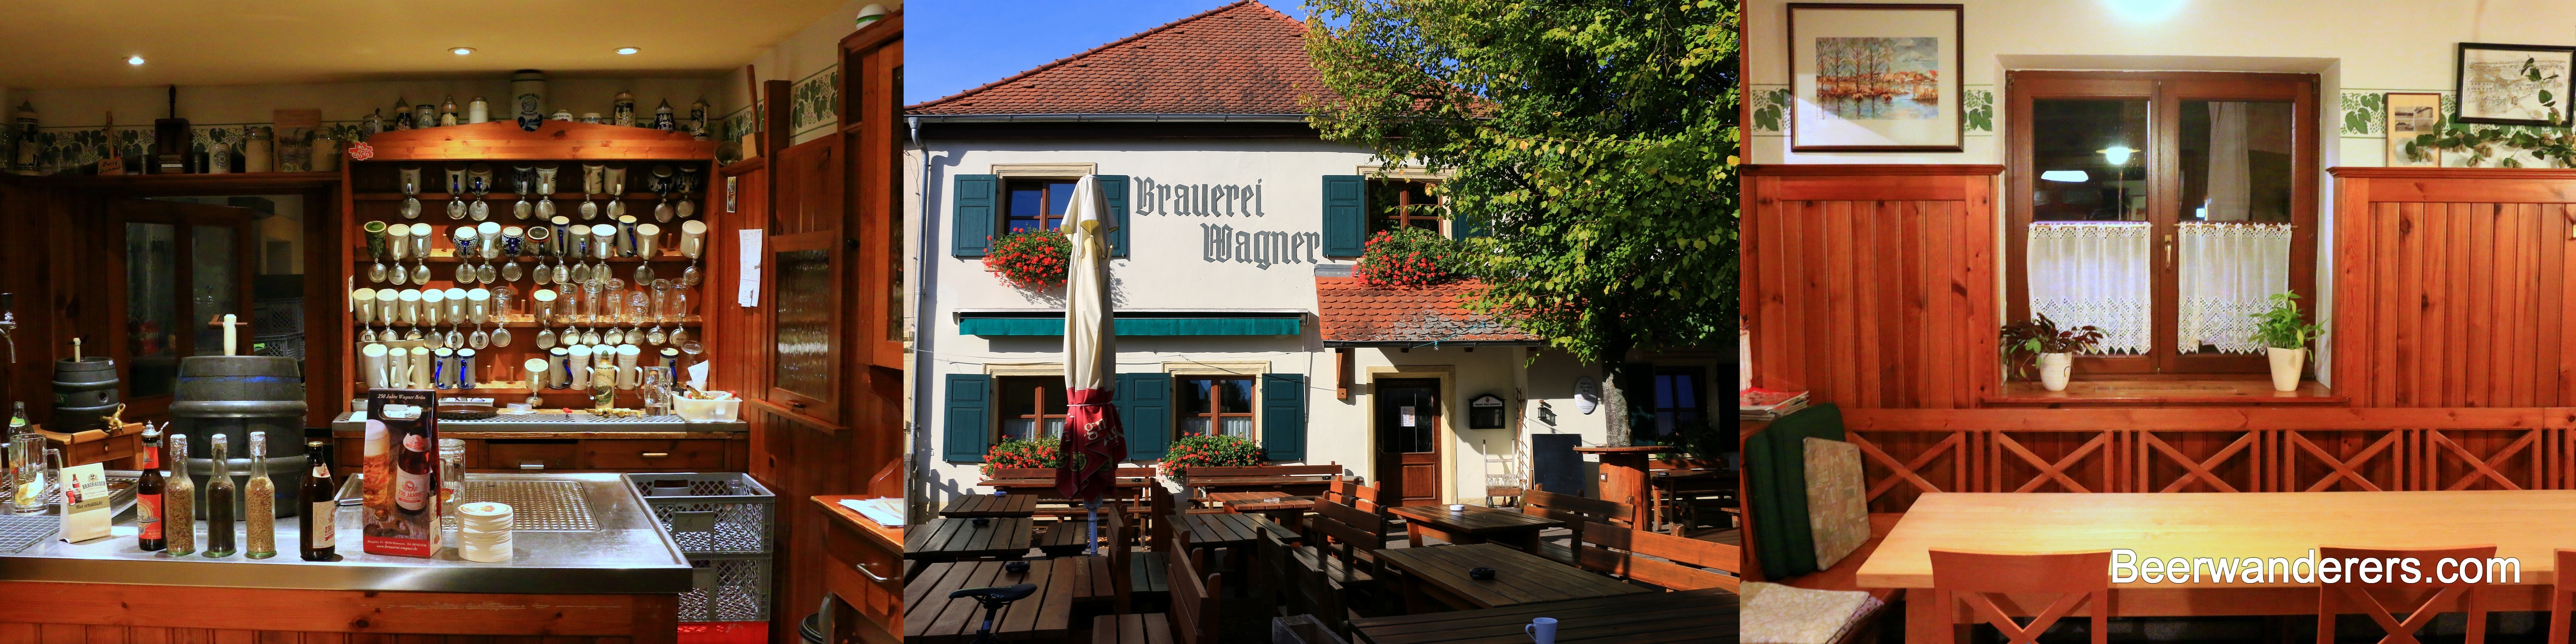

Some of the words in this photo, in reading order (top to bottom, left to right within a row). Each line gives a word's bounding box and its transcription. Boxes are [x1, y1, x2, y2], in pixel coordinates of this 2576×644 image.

[1133, 176, 1265, 217] Brauerei
[1199, 223, 1320, 271] Wagner
[82, 481, 106, 490] BRAURAUSCH
